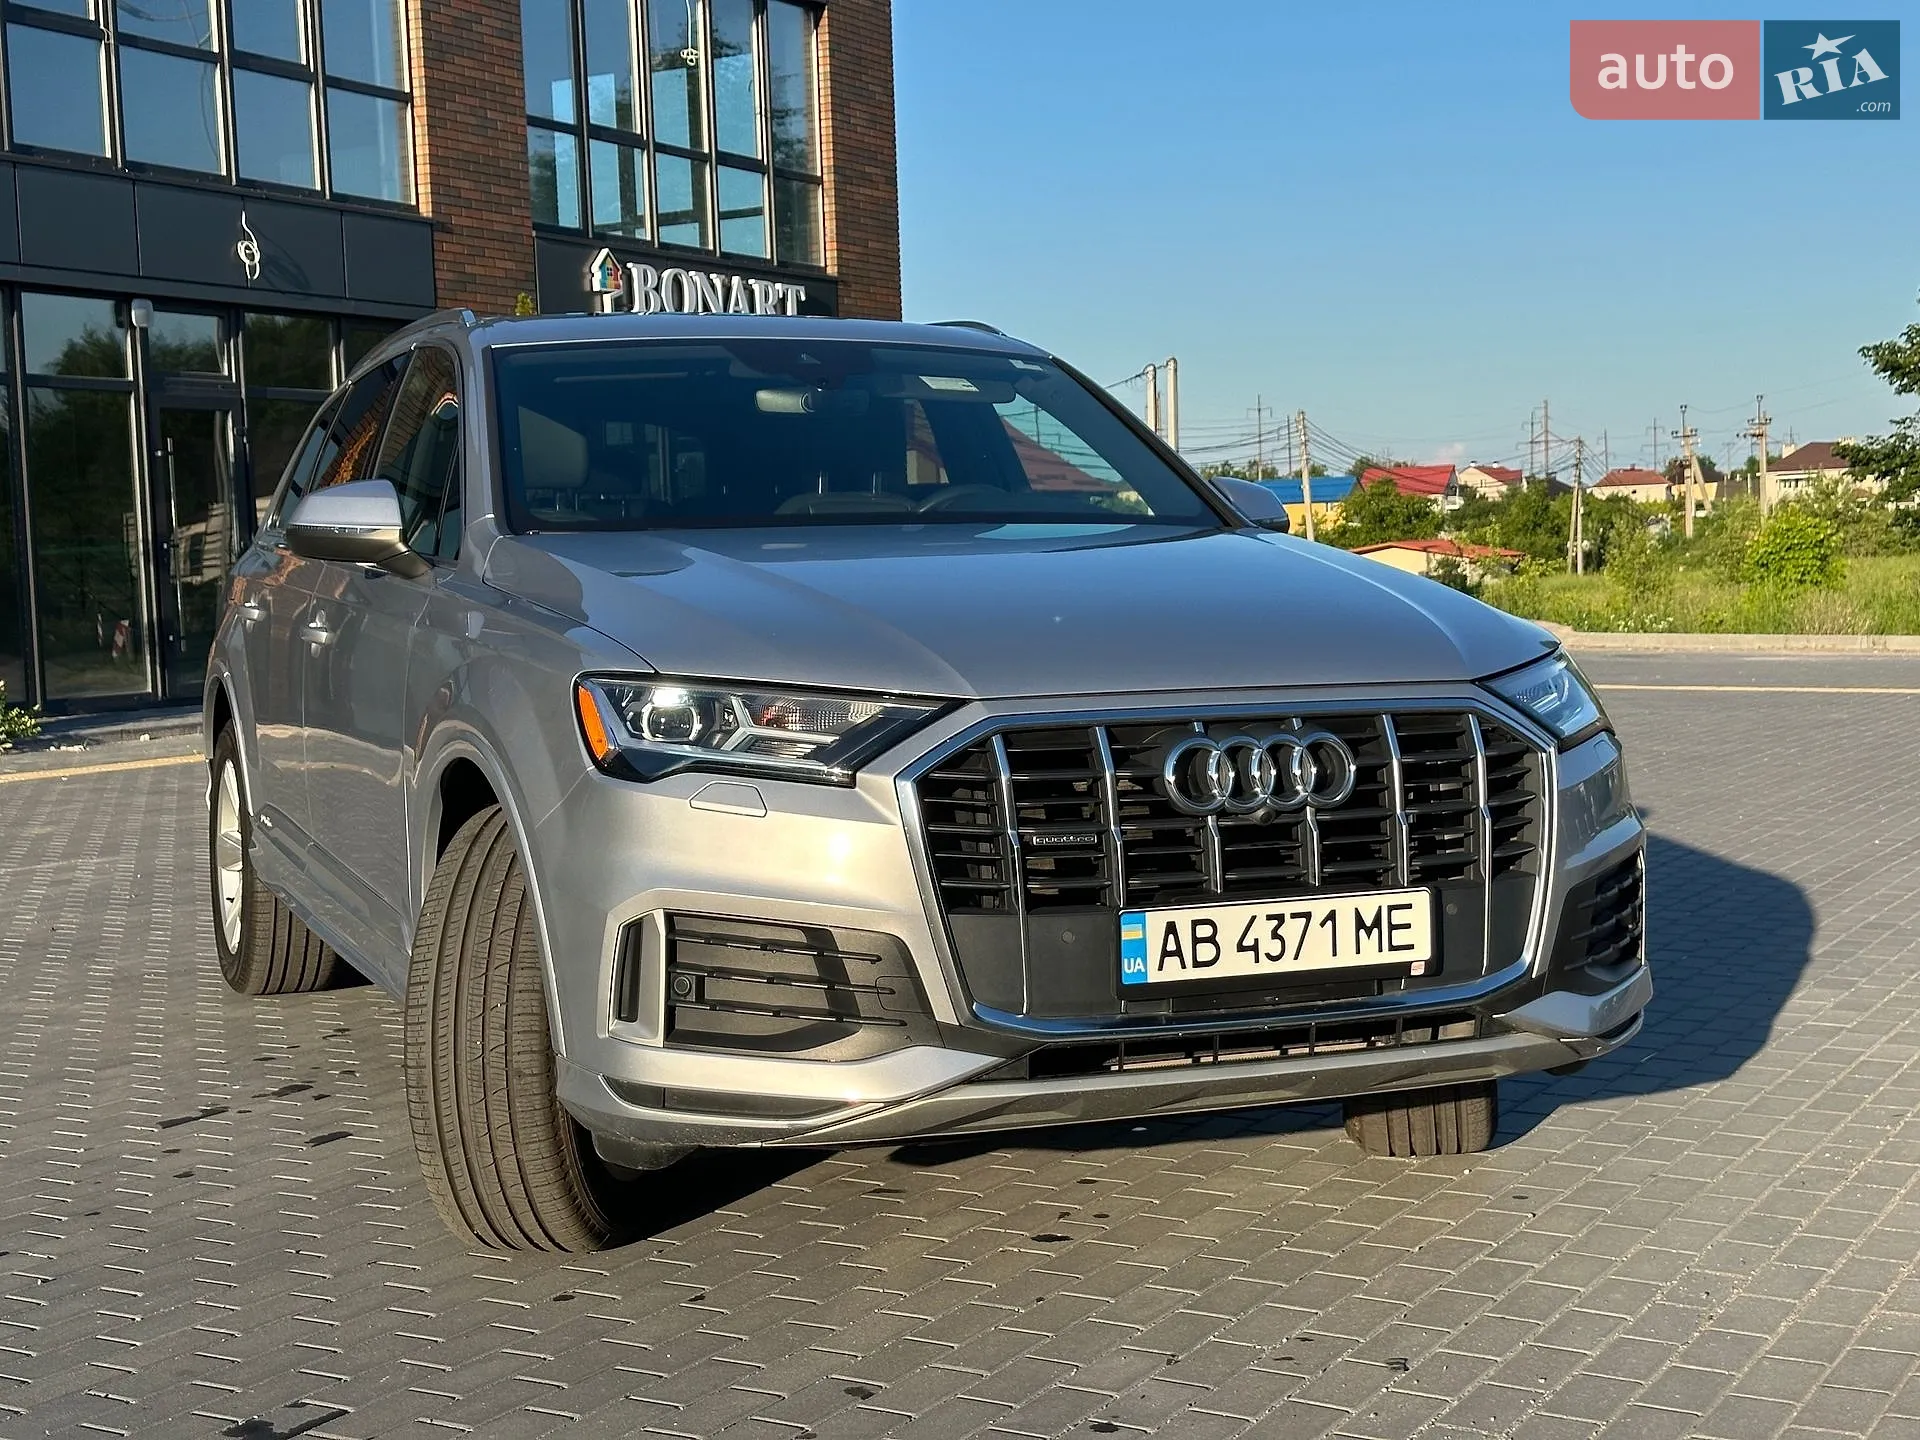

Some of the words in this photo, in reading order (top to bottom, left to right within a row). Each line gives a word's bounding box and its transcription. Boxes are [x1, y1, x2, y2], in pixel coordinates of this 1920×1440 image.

[627, 262, 806, 316] BONART
[1036, 835, 1095, 845] quattro
[1157, 918, 1222, 971] AB
[1236, 909, 1338, 964] 4371
[1355, 903, 1415, 955] ME
[1124, 958, 1146, 974] UA
